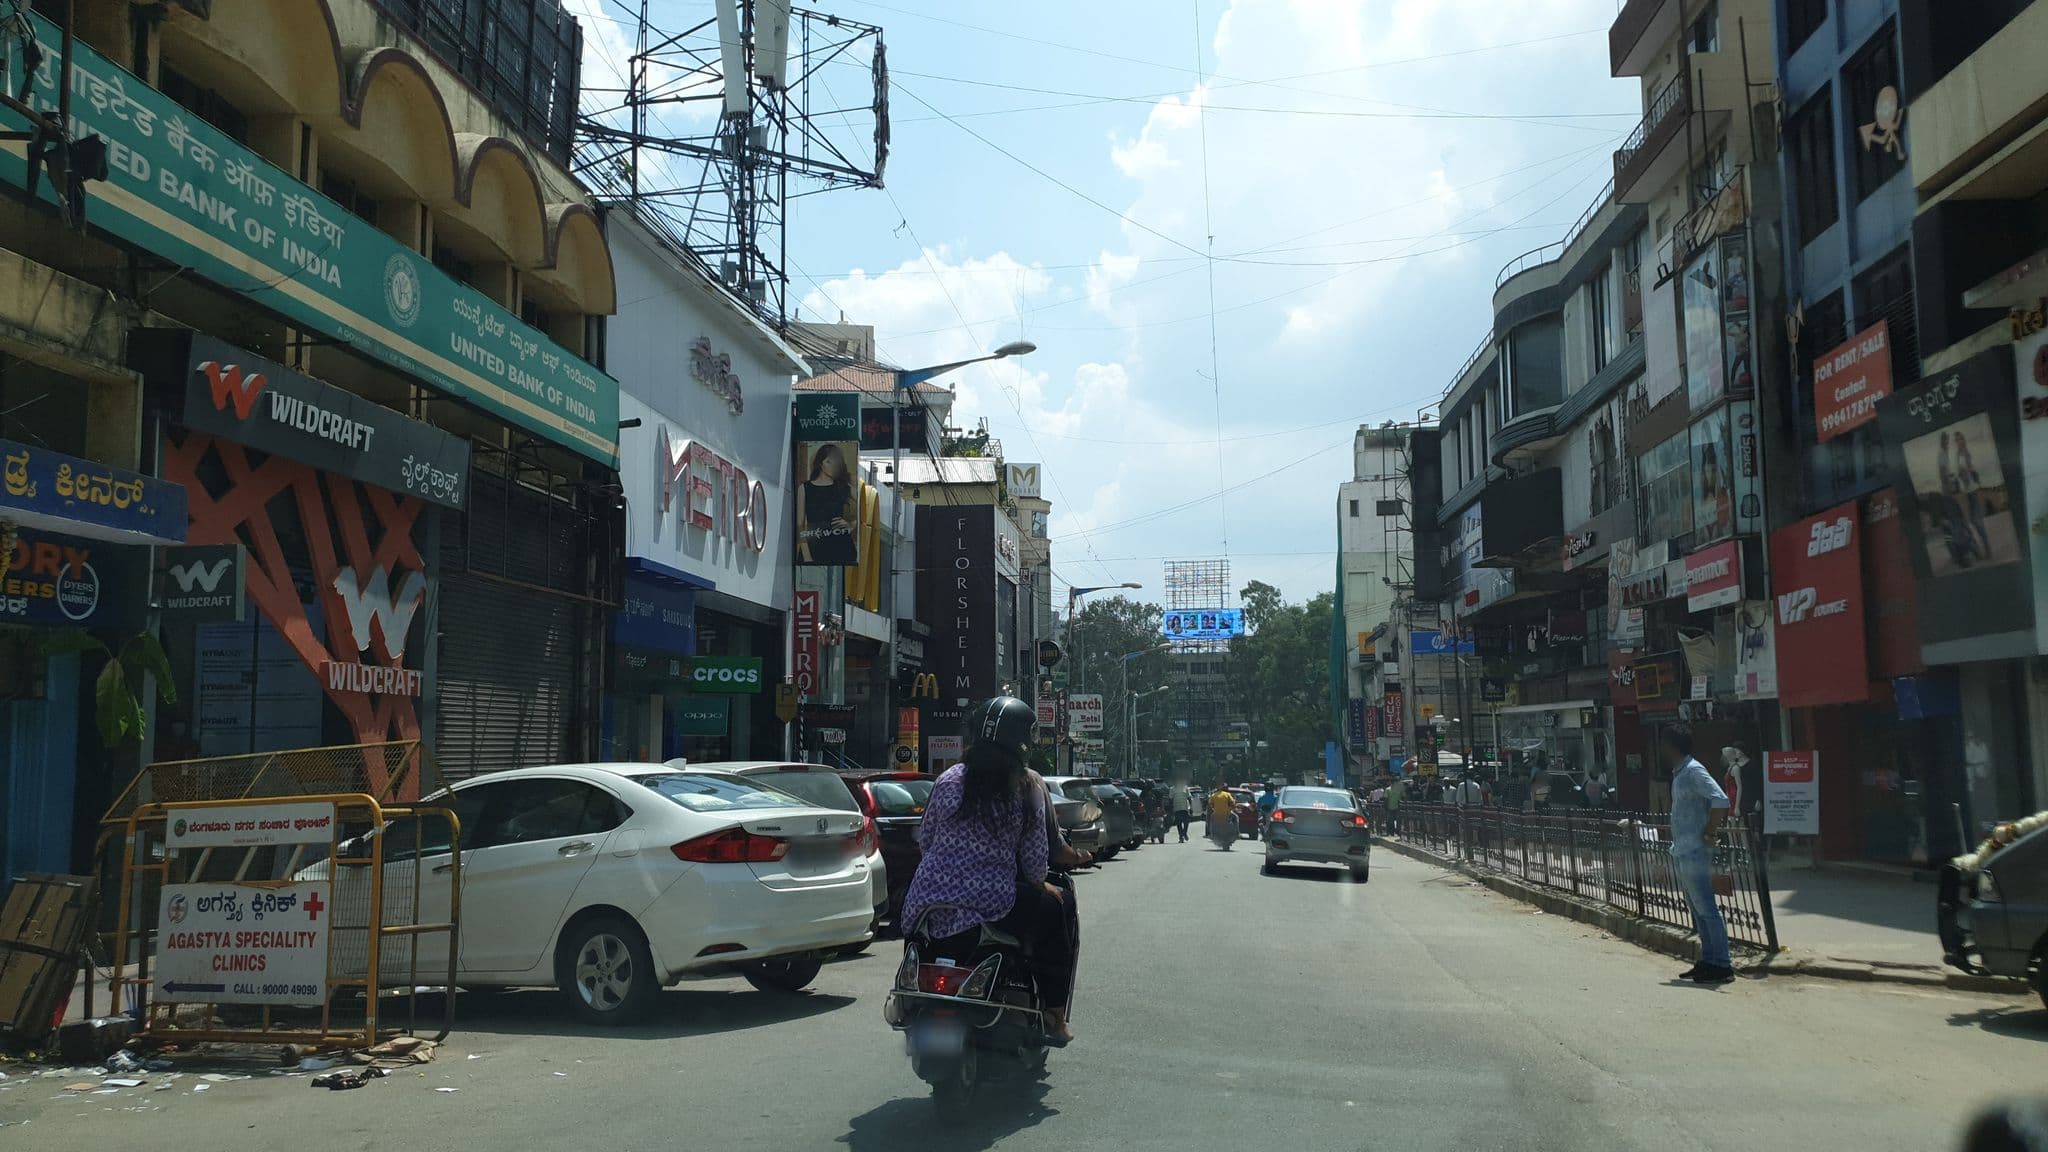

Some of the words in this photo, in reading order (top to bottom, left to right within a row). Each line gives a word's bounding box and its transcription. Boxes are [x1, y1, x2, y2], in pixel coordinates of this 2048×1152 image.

[164, 115, 219, 174] बैंक
[281, 191, 344, 249] इंडिया
[159, 167, 237, 232] BANK
[244, 217, 276, 249] OF
[281, 236, 341, 289] INDIA
[450, 331, 505, 377] UNITED
[507, 363, 544, 399] BANK
[547, 386, 563, 406] OF
[565, 394, 597, 424] INDIA
[1814, 361, 1833, 385] FOR
[1834, 375, 1867, 402] Contact
[266, 390, 375, 452] WILDCRAFT
[799, 416, 856, 429] WOODLAND
[656, 423, 768, 553] METRO
[167, 595, 233, 609] WILDCRAFT
[955, 518, 970, 689] FLORSHEIM
[1778, 587, 1816, 625] VIP
[796, 595, 815, 691] METRO
[328, 661, 422, 697] WILDCRAFT
[693, 666, 758, 683] crocs
[932, 710, 963, 719] RUSMI
[1068, 696, 1101, 710] narch
[1386, 696, 1395, 733] JUTE
[251, 892, 297, 921] ಕ್ಲಿನಿಕ್
[167, 931, 231, 949] AGASTYA
[235, 930, 317, 949] SPECIALITY
[212, 953, 267, 972] CLINICS
[233, 983, 256, 995] CALL
[262, 984, 289, 996] 90000
[290, 984, 318, 996] 49090
